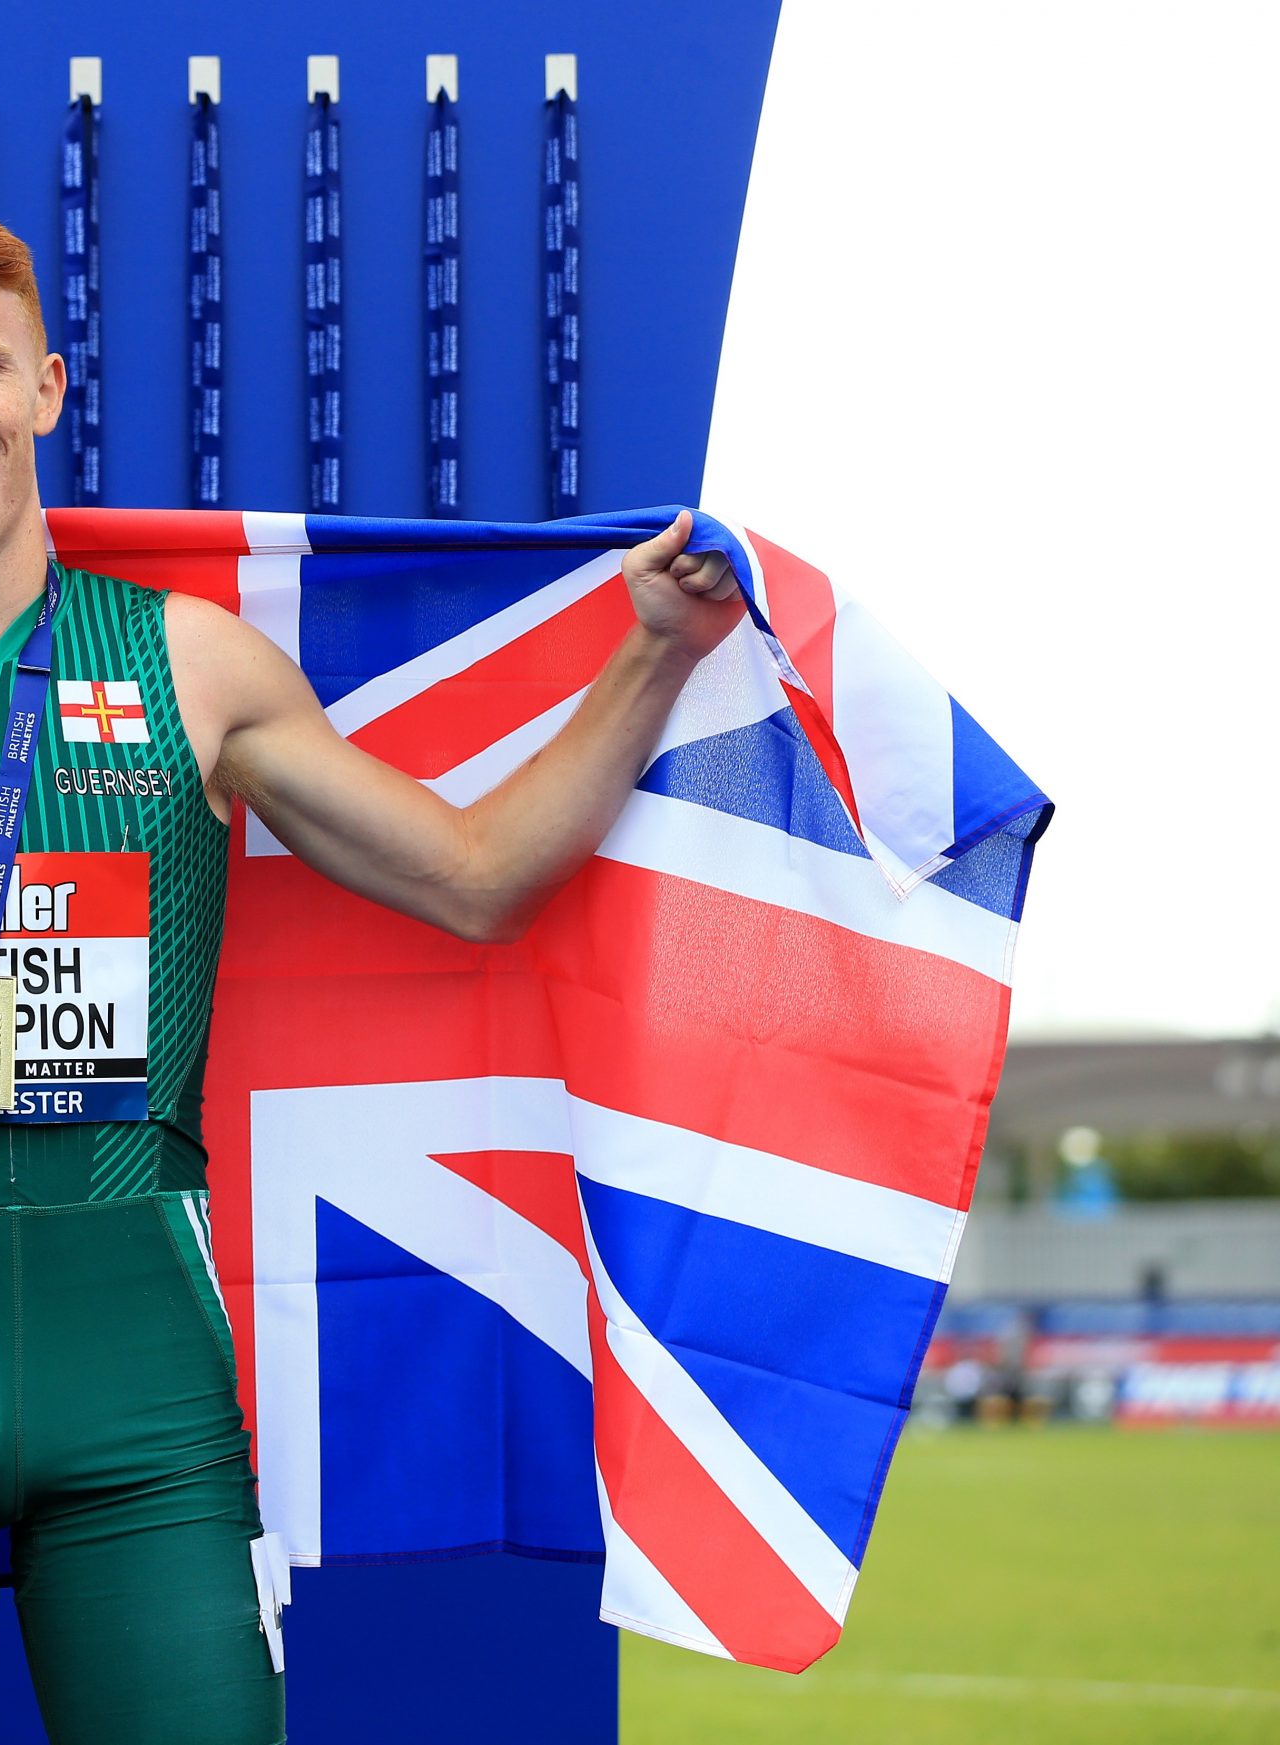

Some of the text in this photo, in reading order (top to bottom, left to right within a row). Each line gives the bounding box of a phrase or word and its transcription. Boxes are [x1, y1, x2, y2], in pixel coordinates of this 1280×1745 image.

[7, 711, 26, 760] BRITISH
[19, 712, 36, 763] ATHLETICS
[55, 767, 173, 796] GUERNSEY
[4, 787, 22, 839] ATHLETICS
[25, 1062, 96, 1077] MATTER
